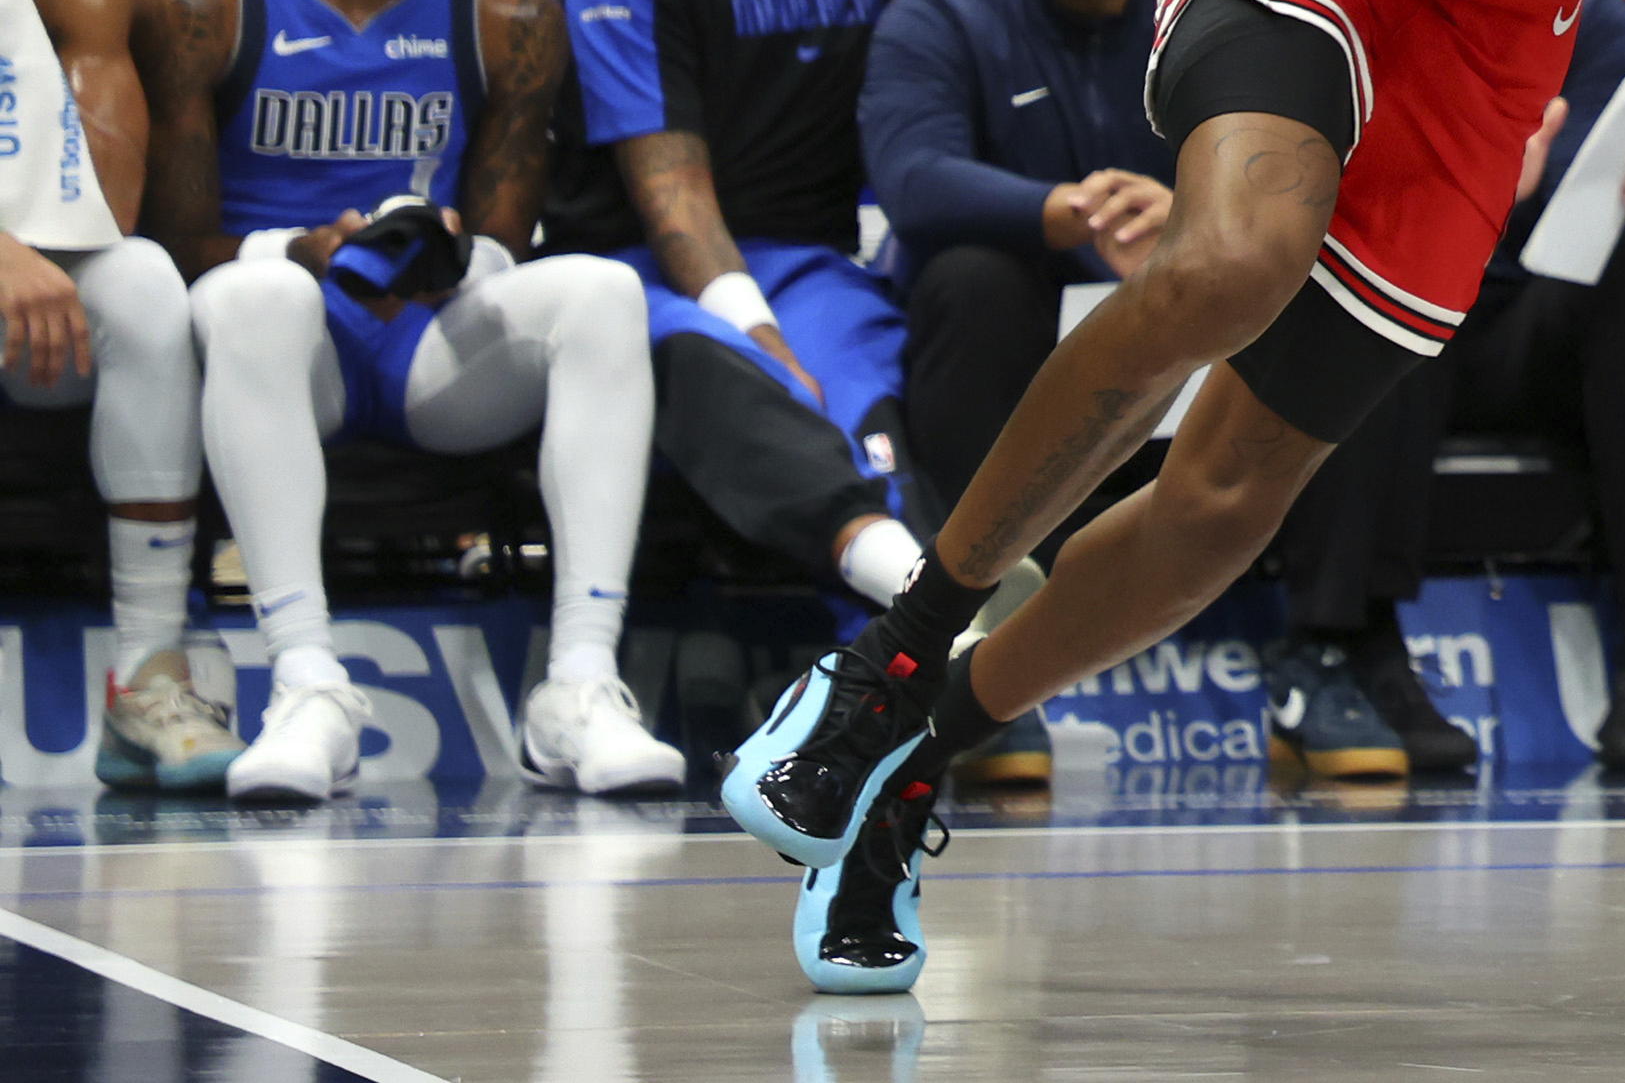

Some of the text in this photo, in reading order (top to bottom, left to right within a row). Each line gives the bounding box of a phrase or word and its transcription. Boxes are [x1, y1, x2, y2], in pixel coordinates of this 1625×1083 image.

[384, 33, 448, 60] chime
[251, 87, 453, 160] DALLAS
[1098, 708, 1272, 763] dical
